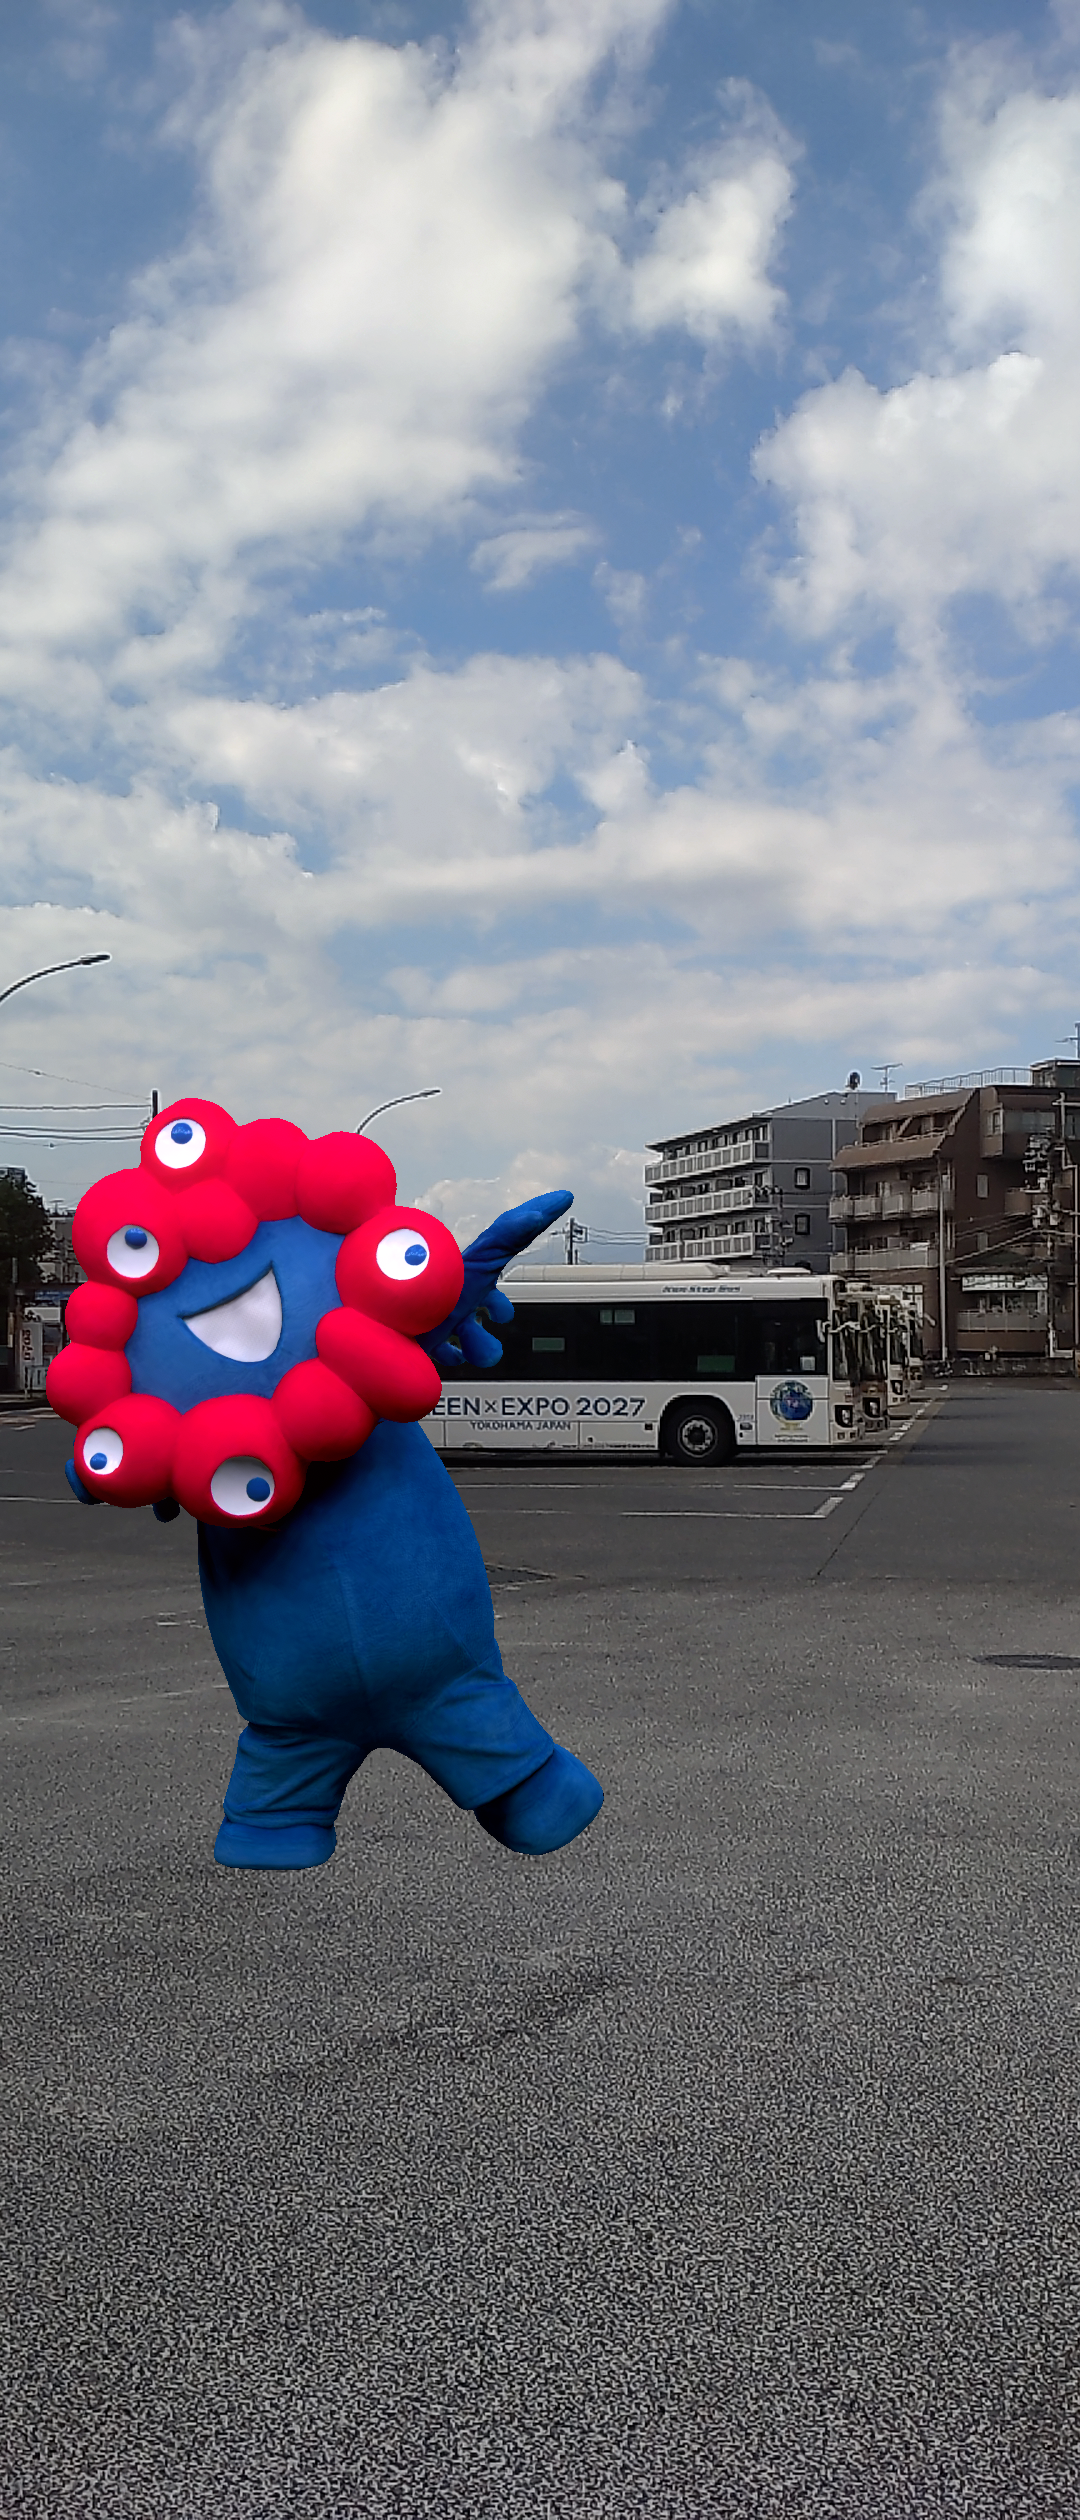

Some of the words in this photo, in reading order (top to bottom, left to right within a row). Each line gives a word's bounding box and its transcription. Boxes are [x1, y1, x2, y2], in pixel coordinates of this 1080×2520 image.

[427, 1397, 570, 1416] EEN×EXPO
[576, 1397, 645, 1416] 2027
[470, 1420, 532, 1430] YOKOHAMA
[536, 1420, 571, 1430] JAPAN
